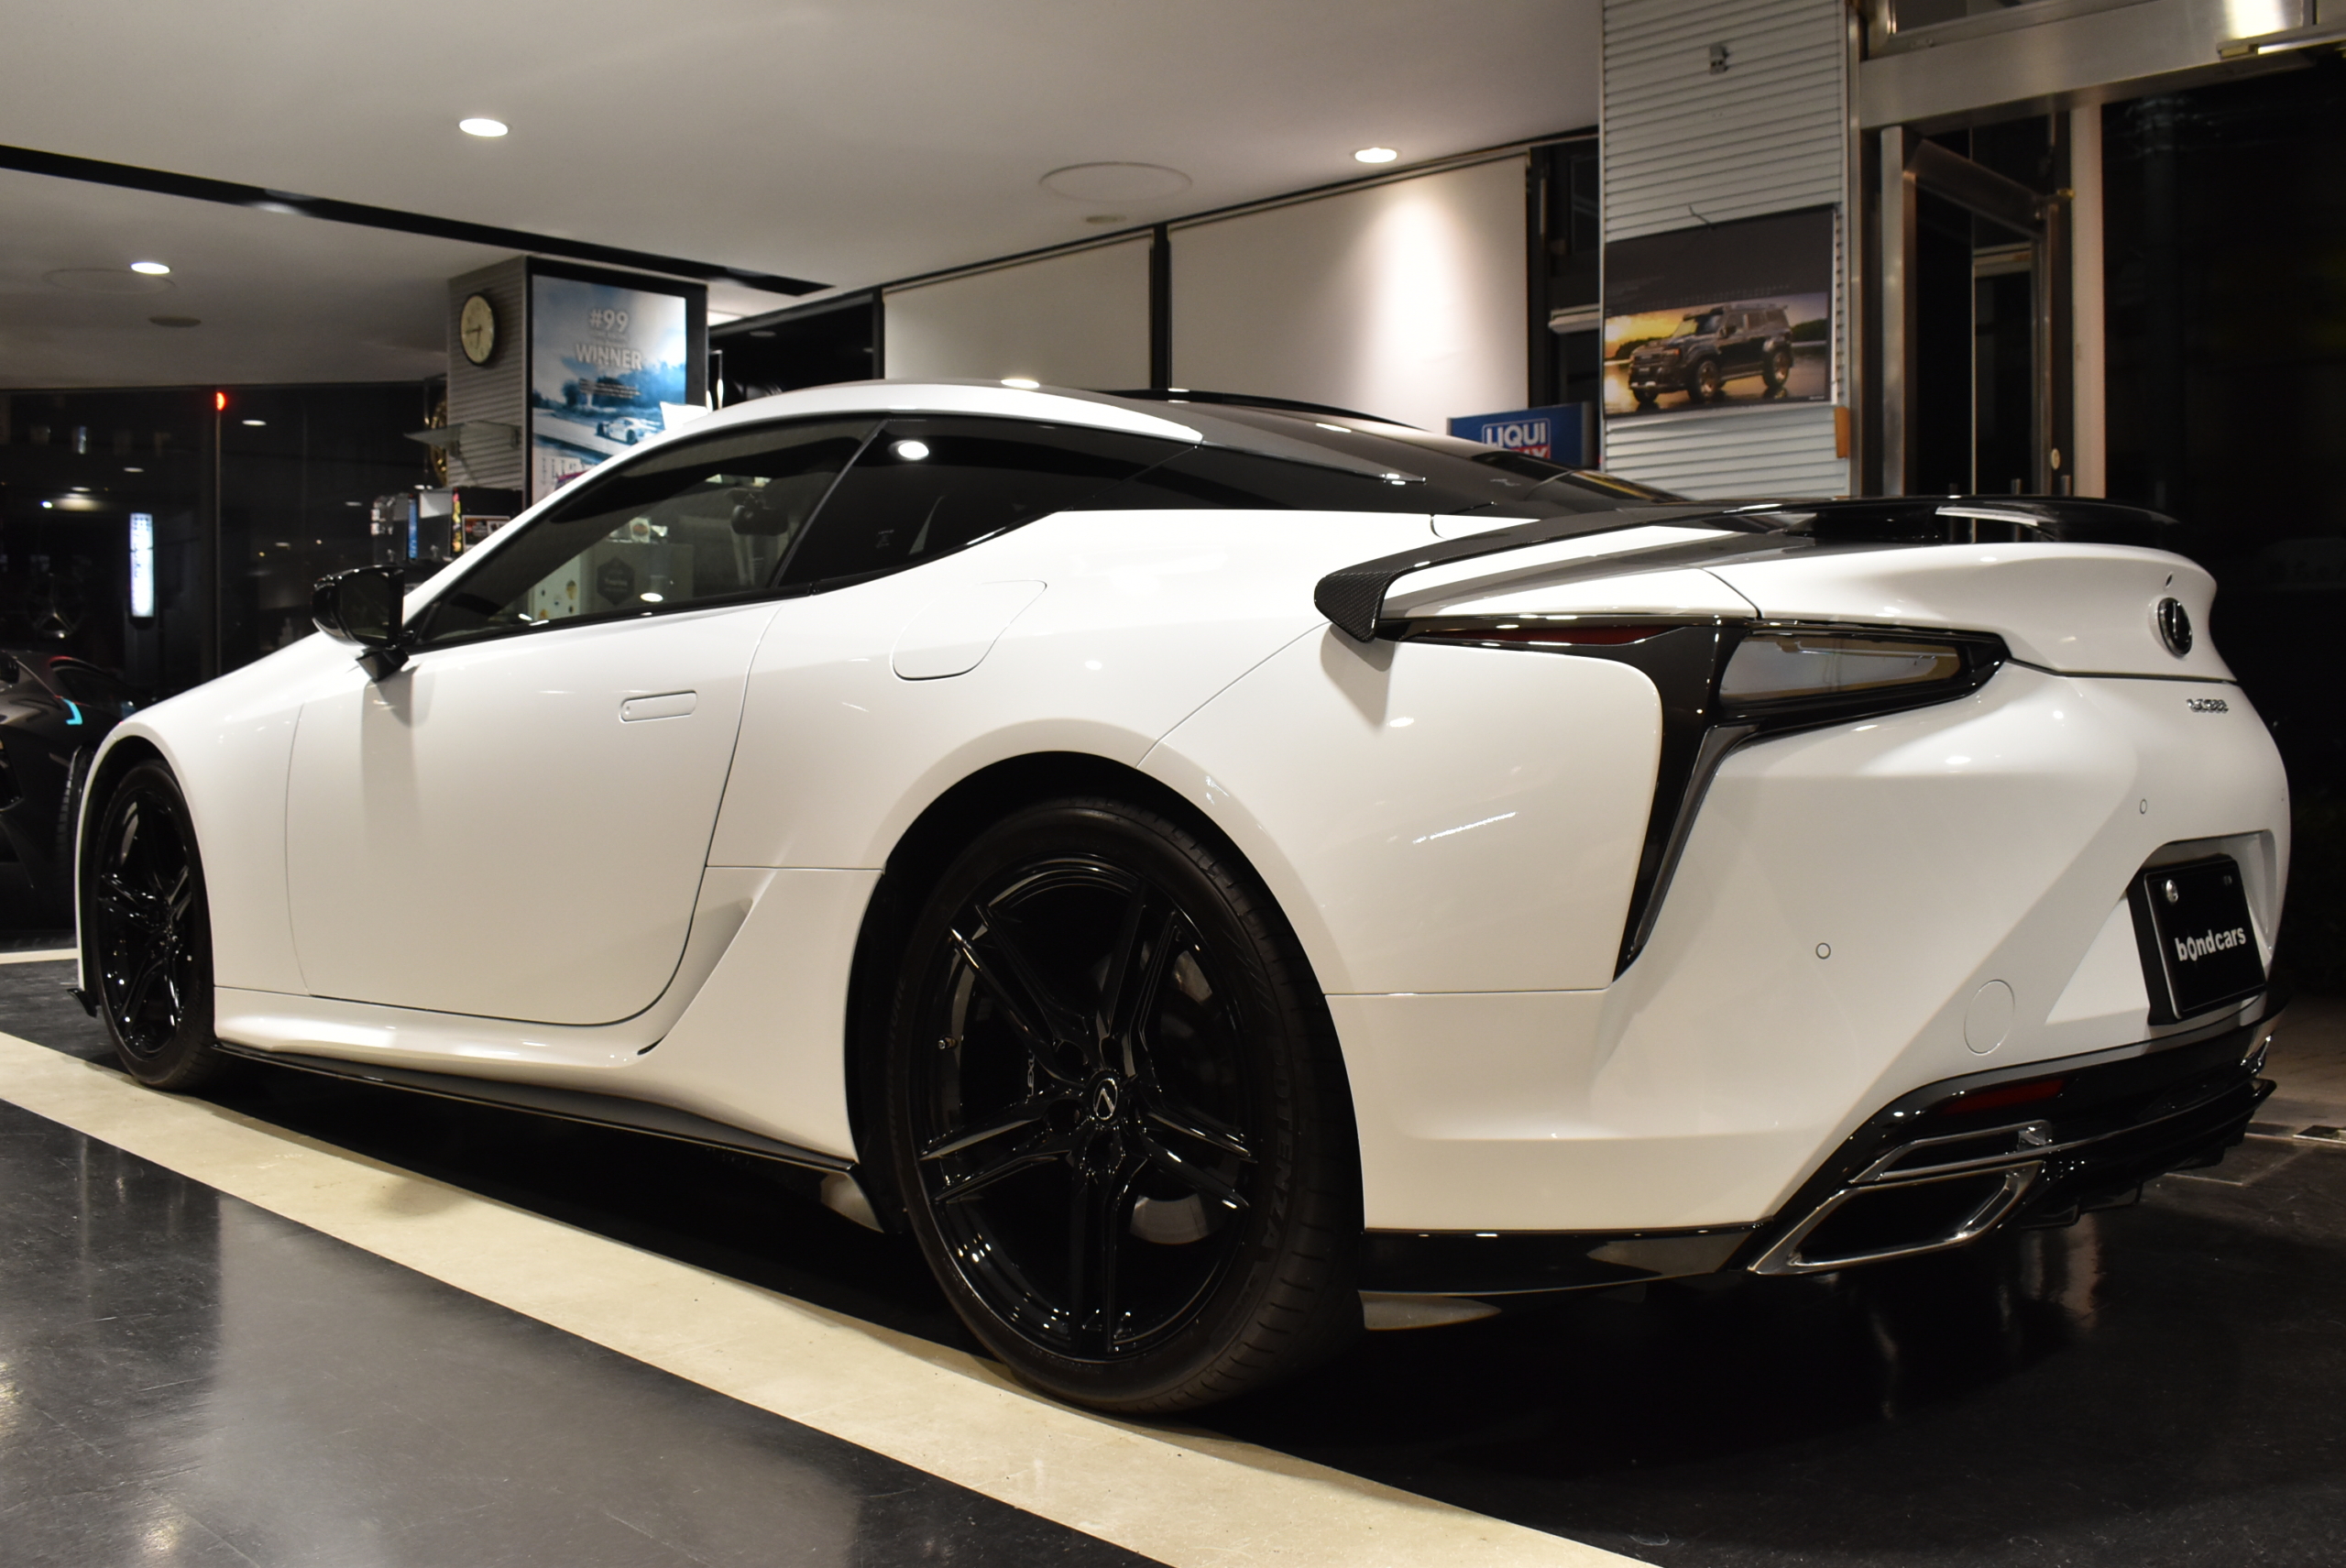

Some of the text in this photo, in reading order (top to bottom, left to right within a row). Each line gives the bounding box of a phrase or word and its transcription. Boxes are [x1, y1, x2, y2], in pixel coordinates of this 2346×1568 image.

[589, 308, 629, 332] #99
[575, 343, 642, 370] WINNER
[1485, 422, 1546, 447] LIQUI
[1027, 1048, 1036, 1098] LEXU
[1261, 1035, 1294, 1249] POTENZA
